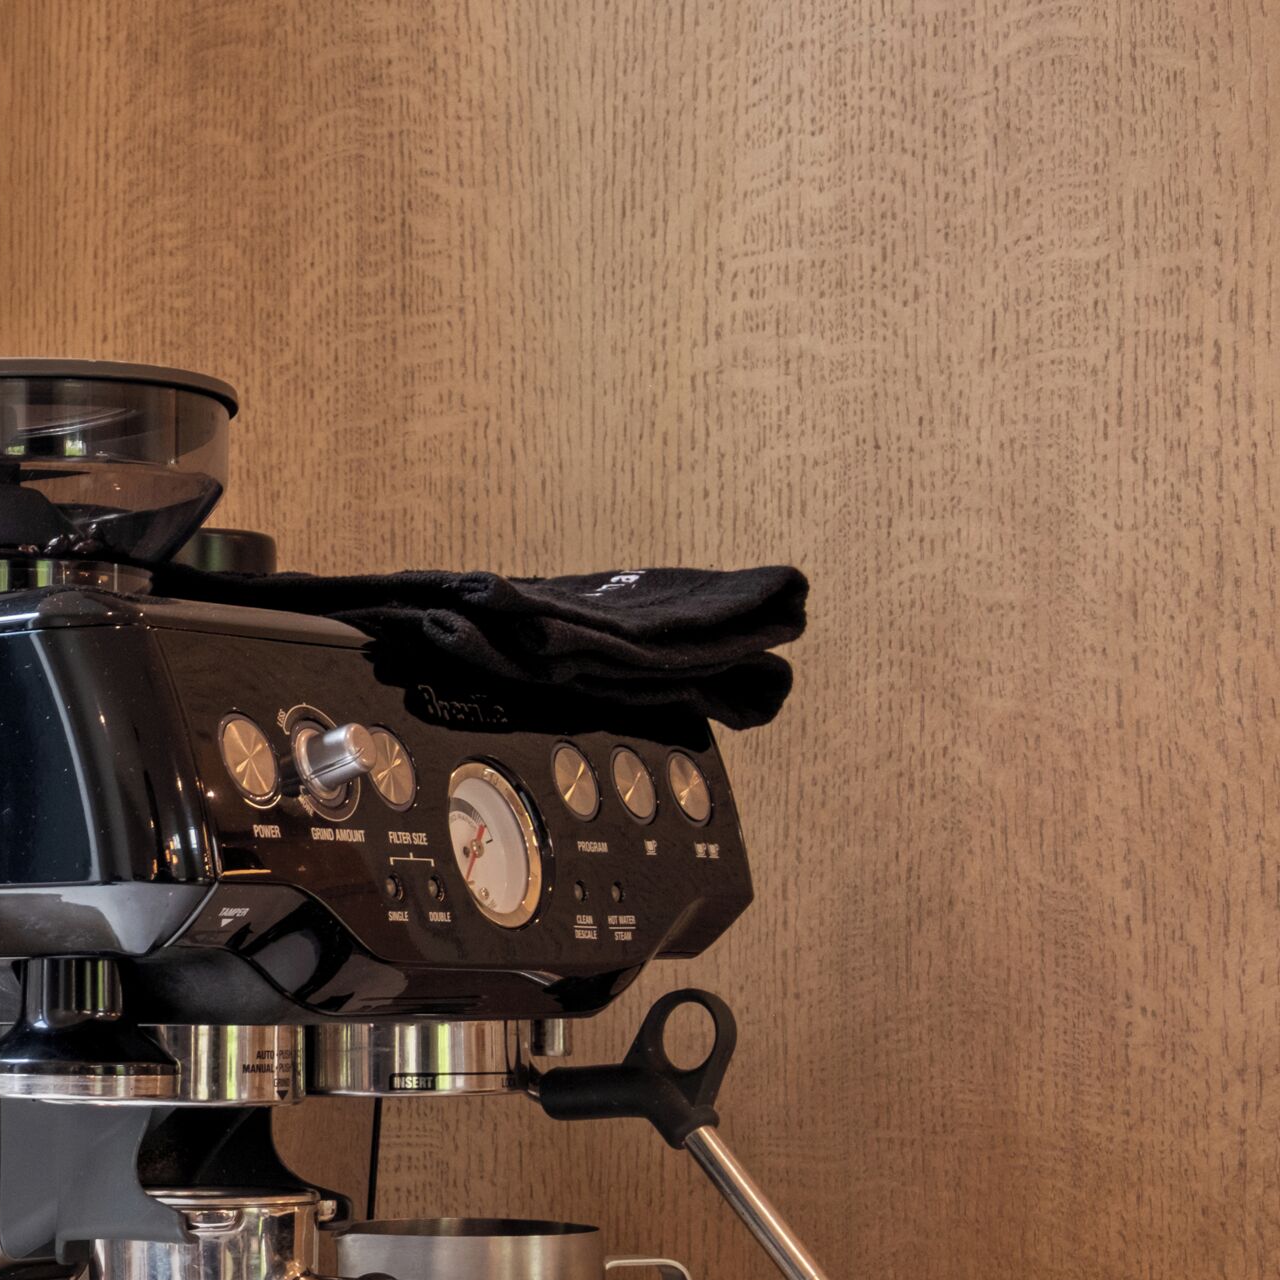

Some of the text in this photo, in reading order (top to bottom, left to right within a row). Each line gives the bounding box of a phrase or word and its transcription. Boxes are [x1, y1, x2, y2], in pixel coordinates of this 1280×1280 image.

[253, 824, 282, 839] POWER
[311, 827, 365, 843] GRIND AMOUNT
[388, 831, 428, 845] FILTER SIZE
[577, 840, 608, 853] PROGRAM
[219, 907, 250, 917] TAMPER
[388, 911, 409, 922] SINGLE
[429, 912, 452, 923] DOUBLE
[576, 914, 594, 925] CLEAN
[607, 915, 636, 925] HOT WATER
[575, 930, 597, 940] DESCALE
[614, 931, 632, 941] STEAM
[256, 1050, 274, 1060] AUTO
[242, 1063, 274, 1073] MANUAL
[393, 1076, 433, 1089] INSERT
